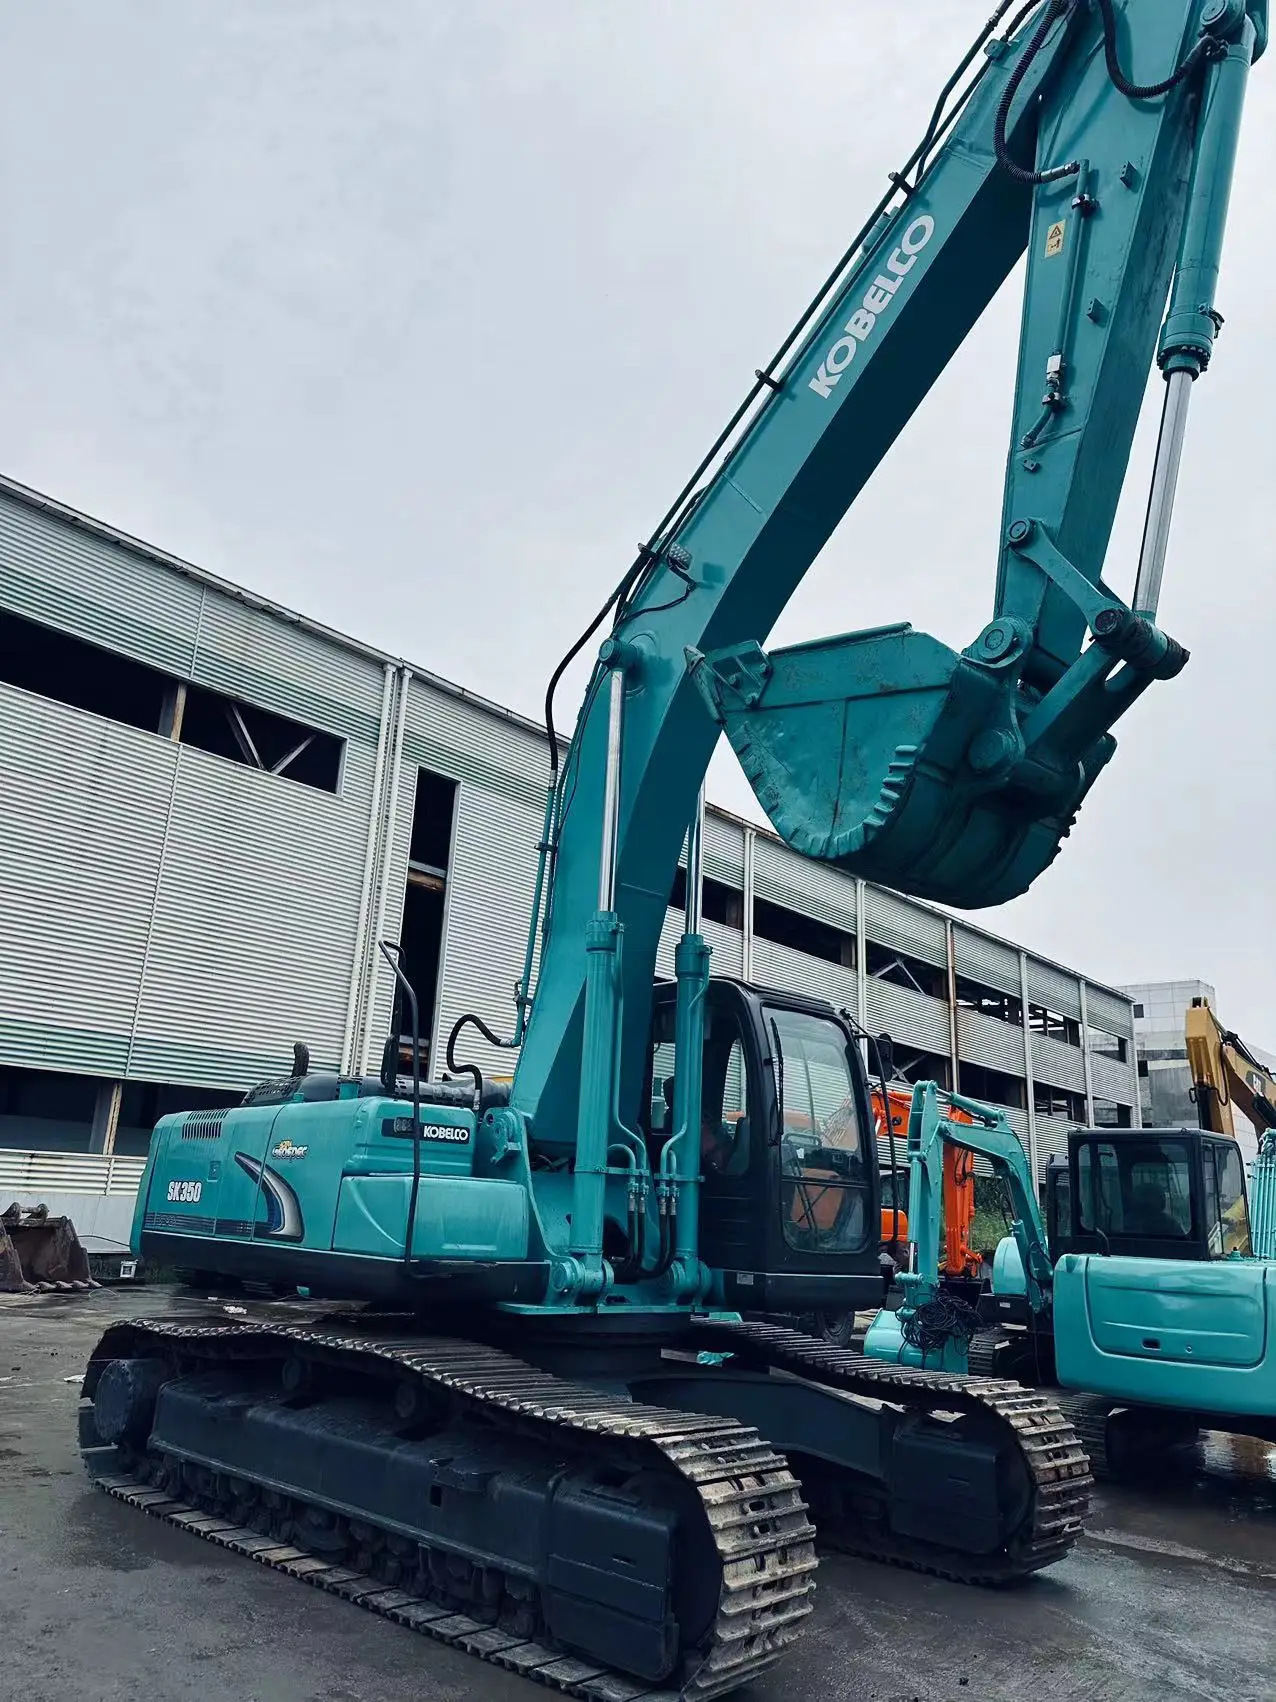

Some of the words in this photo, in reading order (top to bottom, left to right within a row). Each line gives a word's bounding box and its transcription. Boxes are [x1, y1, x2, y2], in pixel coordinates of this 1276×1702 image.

[808, 214, 935, 399] KOBELCO
[423, 1125, 469, 1141] KOBELCO
[167, 1181, 202, 1202] SK350
